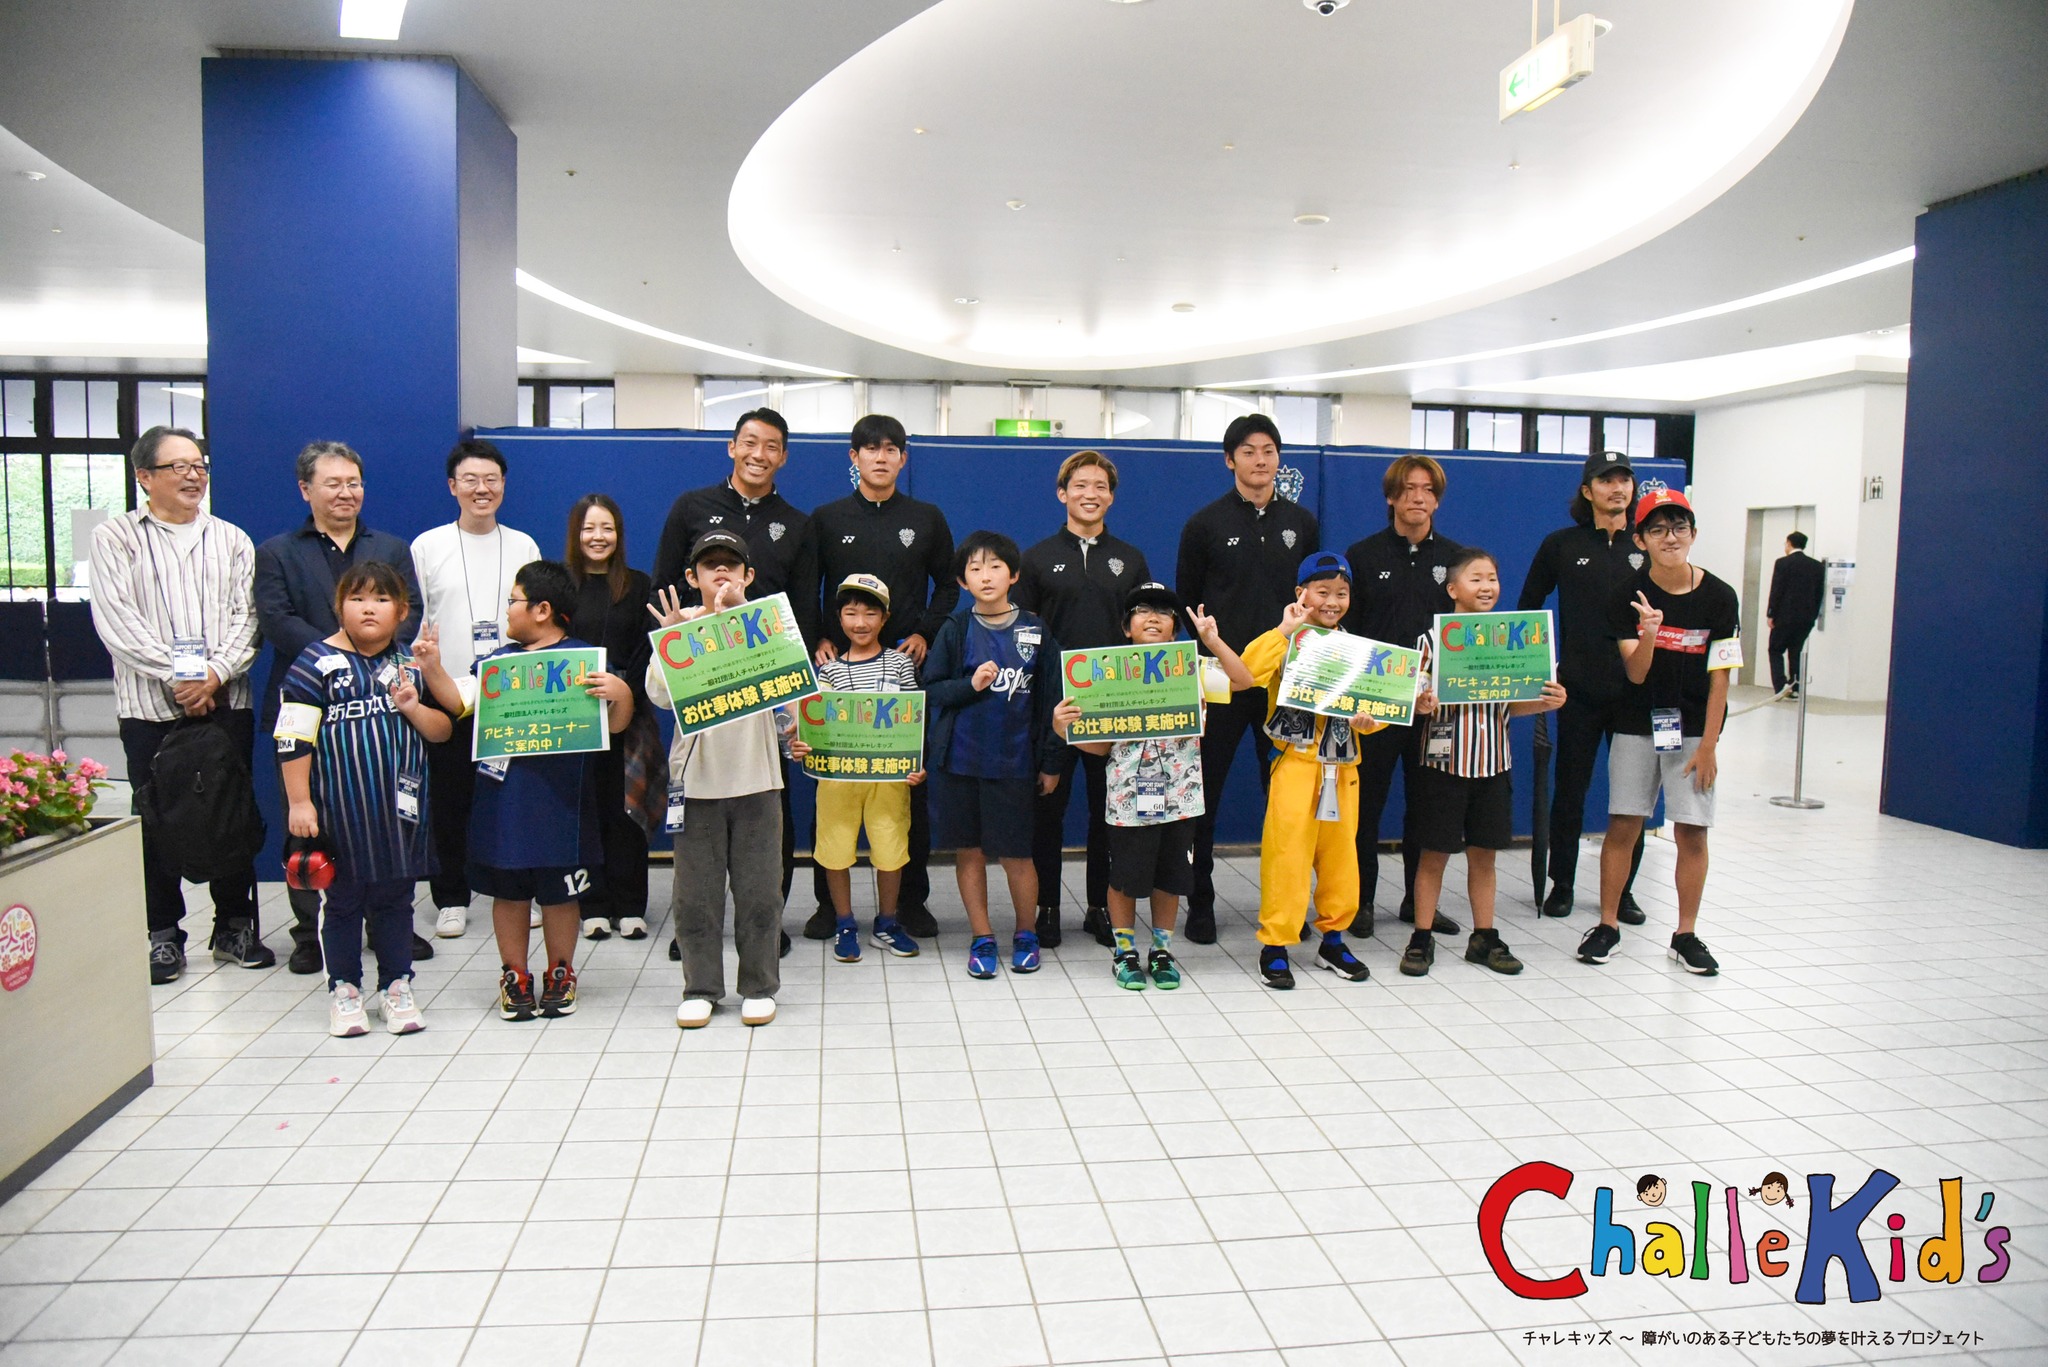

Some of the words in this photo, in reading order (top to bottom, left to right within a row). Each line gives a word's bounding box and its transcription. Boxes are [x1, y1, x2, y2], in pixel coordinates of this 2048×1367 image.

[1065, 649, 1196, 688] ChalleKid's
[681, 684, 761, 725] お仕事体験
[800, 694, 922, 729] ChalleKid's
[1071, 716, 1143, 735] お仕事体験
[804, 755, 869, 774] お仕事体験
[1153, 803, 1164, 811] 60
[563, 868, 591, 896] 12
